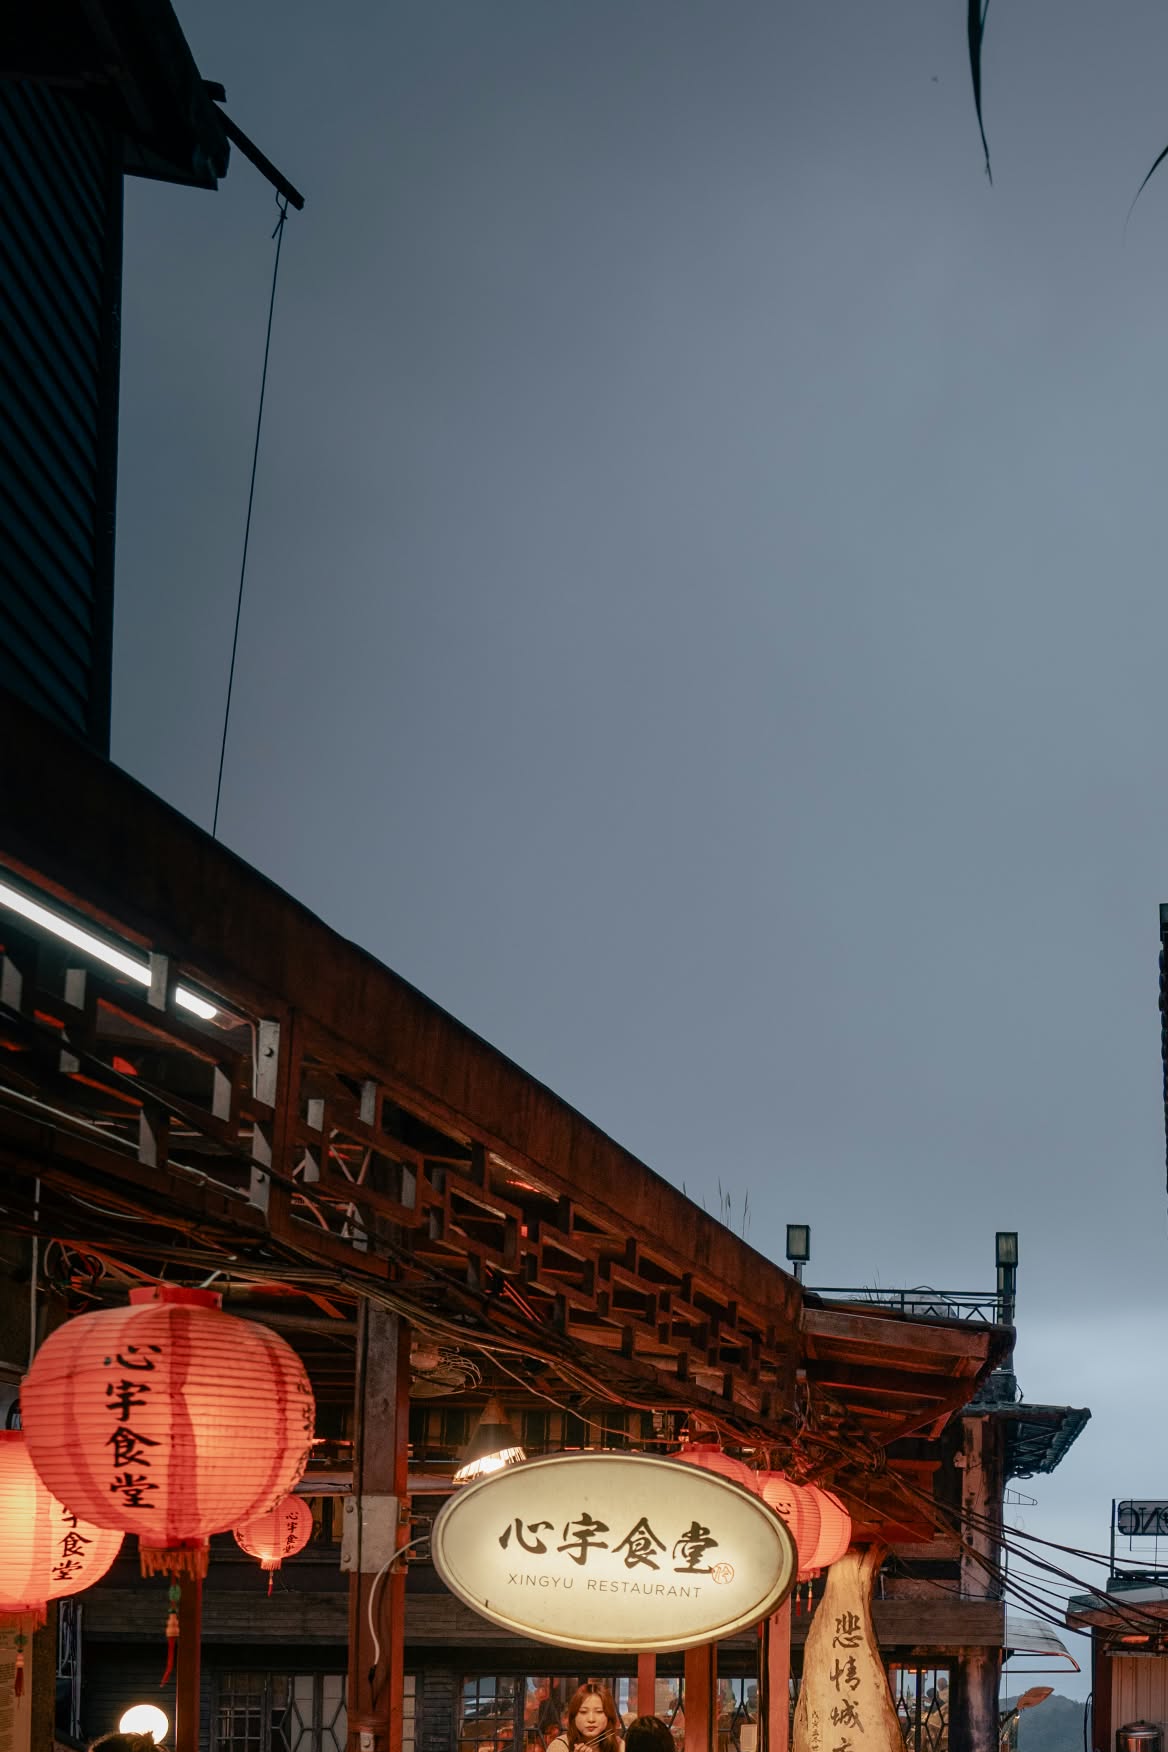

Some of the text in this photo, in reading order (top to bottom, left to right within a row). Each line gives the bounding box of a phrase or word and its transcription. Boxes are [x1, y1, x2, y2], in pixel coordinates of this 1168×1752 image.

[103, 1345, 162, 1509] 心宇食堂
[498, 1512, 719, 1574] 心宇食堂
[507, 1573, 702, 1599] XINGYU RESTAURANT
